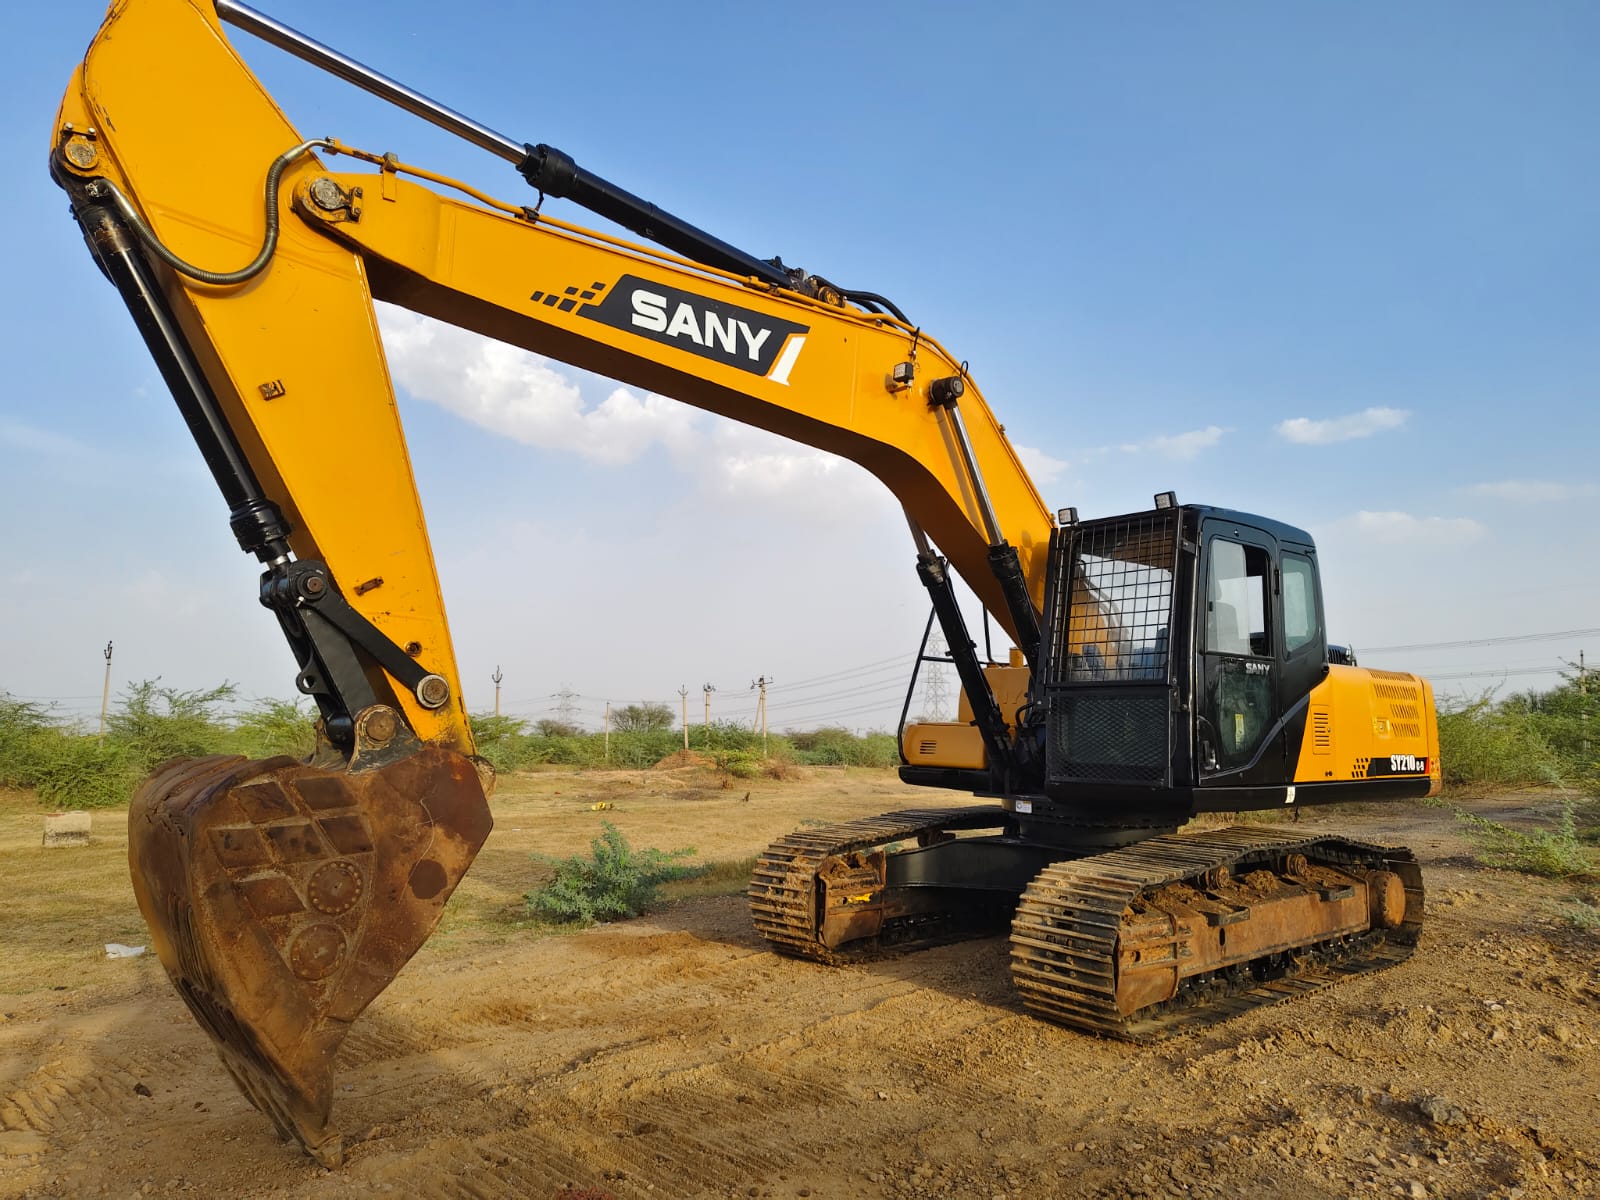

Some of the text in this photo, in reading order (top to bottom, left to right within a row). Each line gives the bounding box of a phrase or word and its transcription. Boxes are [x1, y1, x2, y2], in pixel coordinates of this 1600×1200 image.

[631, 289, 771, 361] SANY
[1245, 663, 1270, 675] SANY
[1390, 754, 1415, 771] SY210
